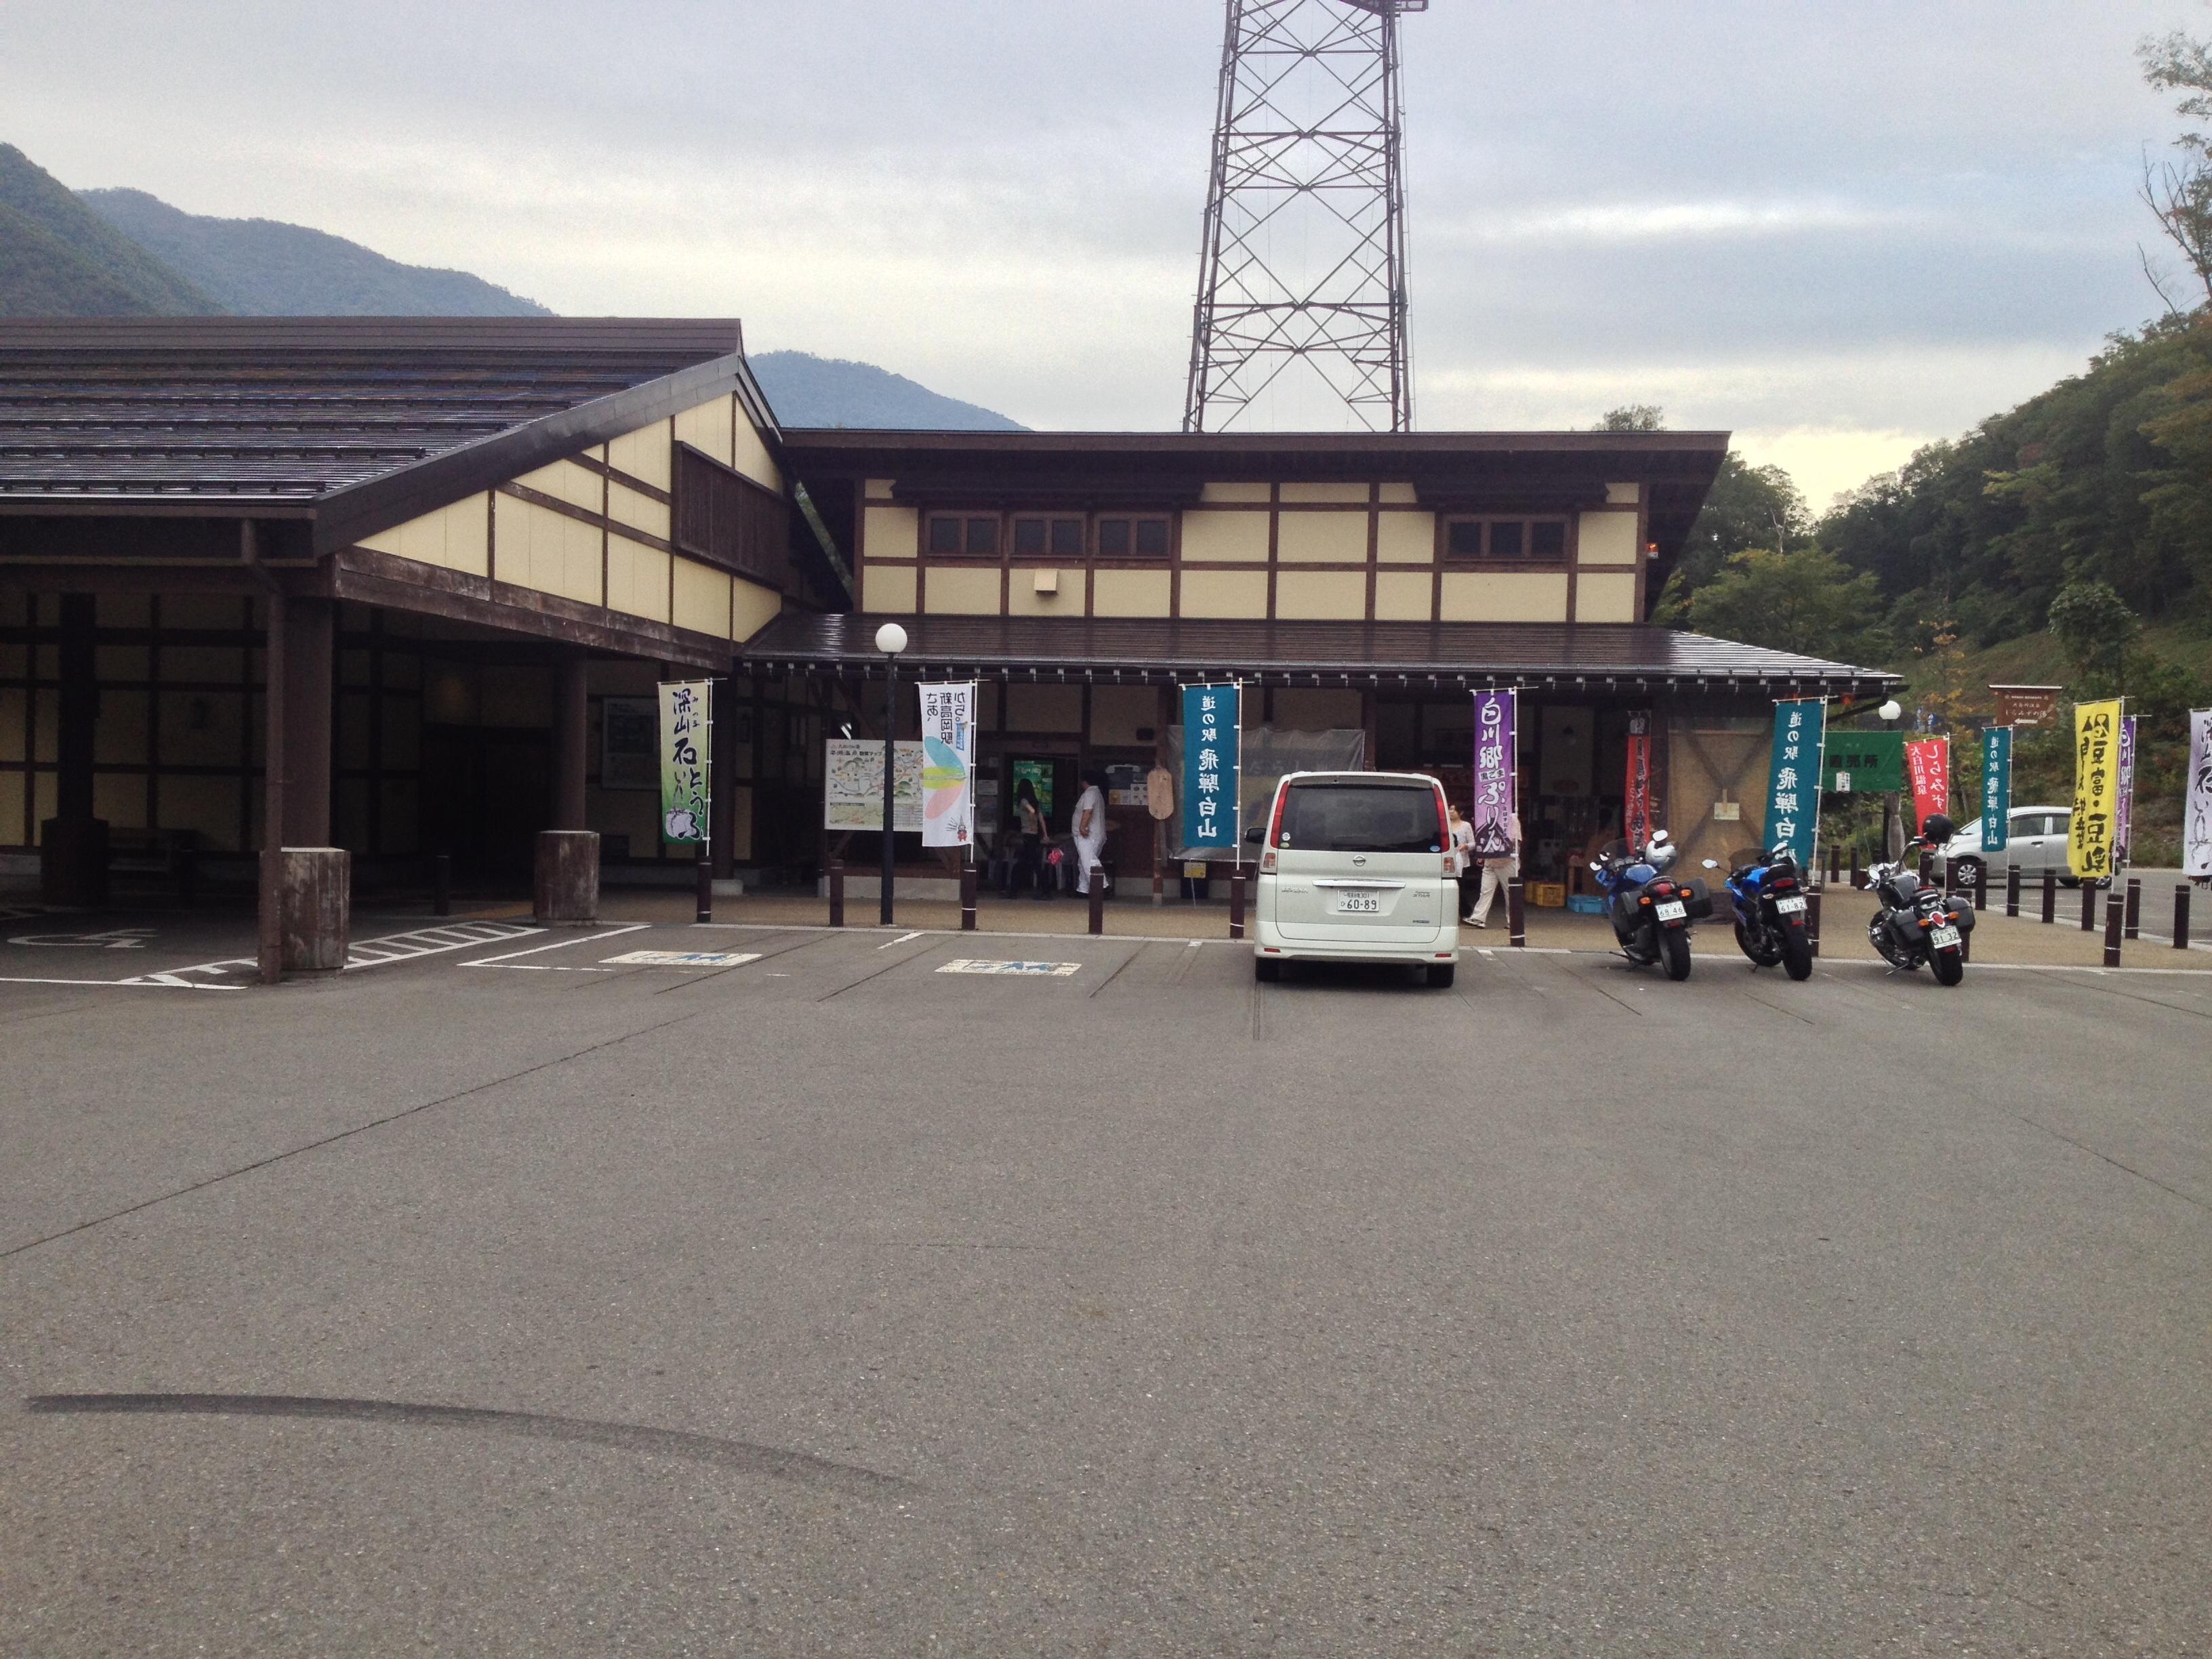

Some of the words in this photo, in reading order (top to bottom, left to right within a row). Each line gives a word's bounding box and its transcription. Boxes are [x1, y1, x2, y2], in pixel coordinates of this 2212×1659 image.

[1479, 697, 1503, 770] 白川郷
[1820, 754, 1878, 769] 直売所
[1477, 781, 1506, 853] ぷりん
[1347, 899, 1376, 910] 60-89
